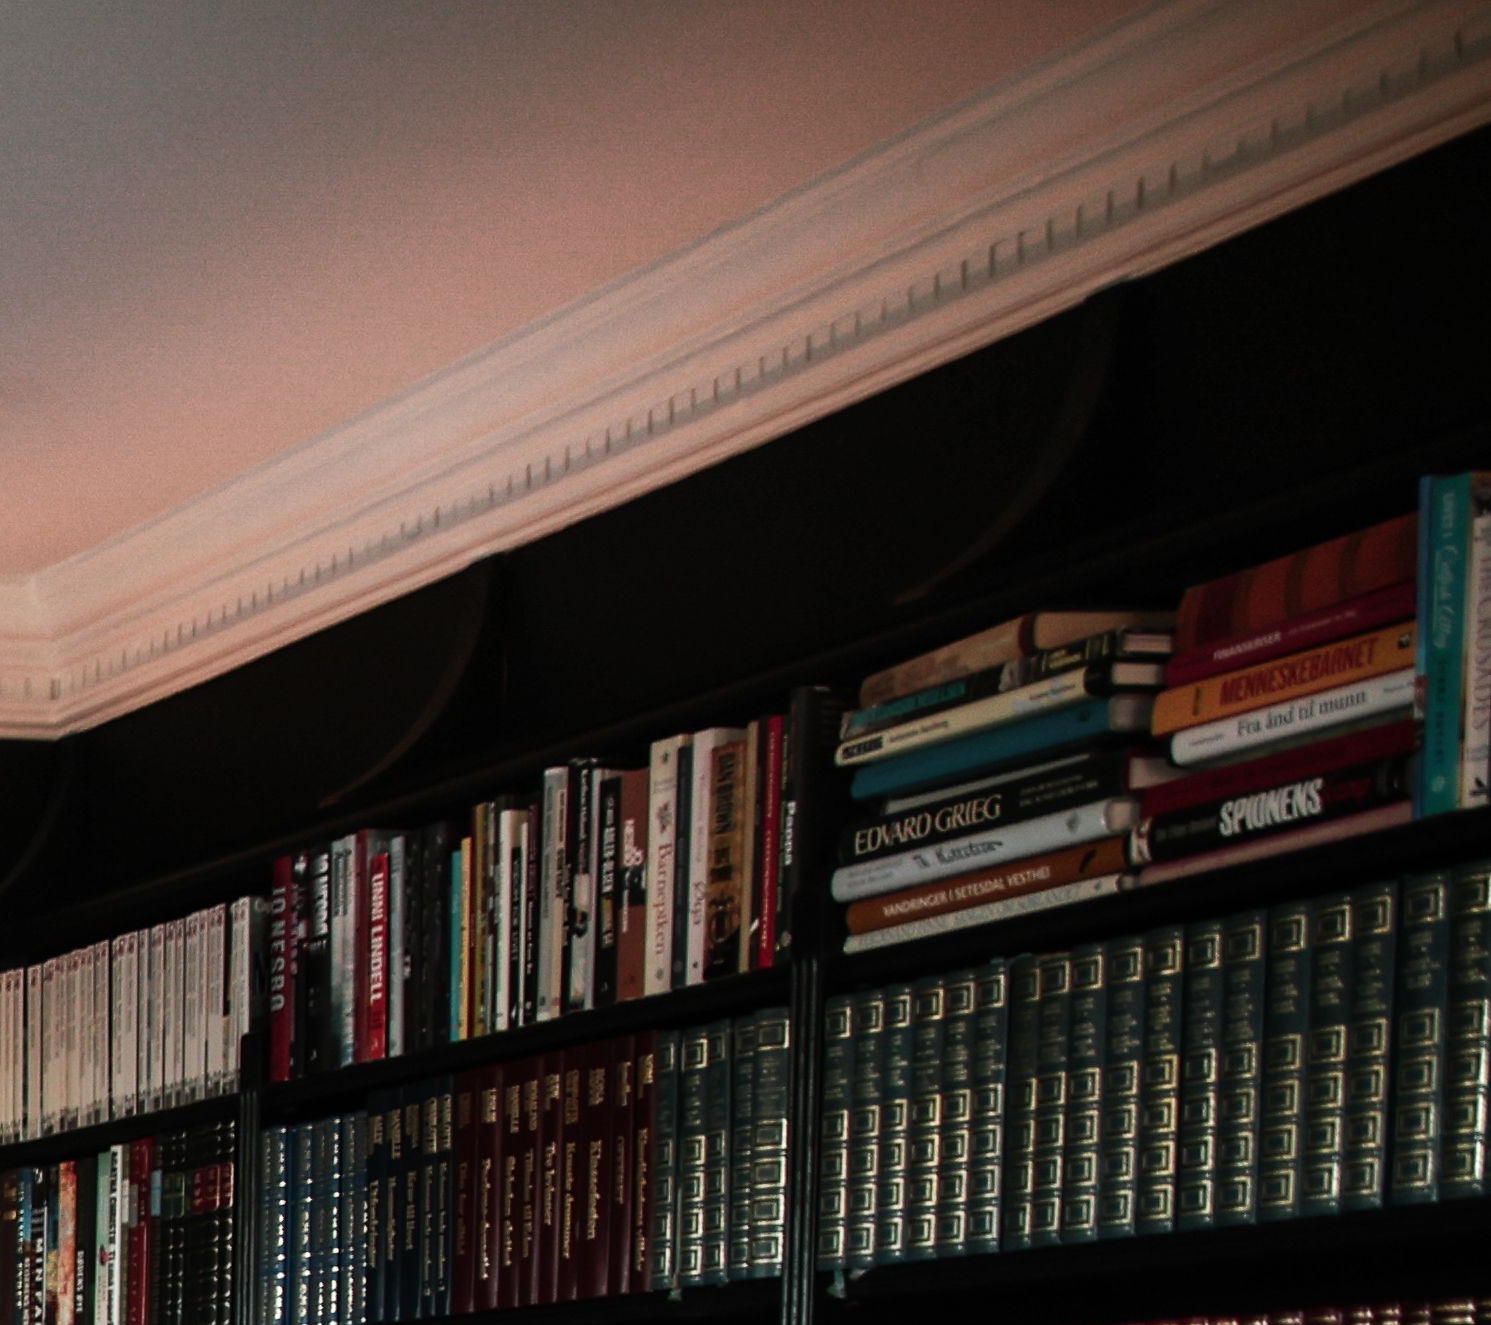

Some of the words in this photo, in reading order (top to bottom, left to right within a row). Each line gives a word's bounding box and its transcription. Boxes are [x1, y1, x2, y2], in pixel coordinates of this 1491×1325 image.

[1220, 639, 1378, 705] MENNESKEBARNET
[1237, 719, 1260, 736] Fra
[1265, 708, 1294, 729] ånd
[1299, 705, 1316, 722] til
[1319, 692, 1367, 714] munn
[935, 794, 1002, 832] GRIEG
[1219, 777, 1324, 837] SPIONENS
[372, 872, 384, 922] UNNI
[654, 843, 673, 955] Barnepiken
[369, 926, 384, 1005] LINDELL
